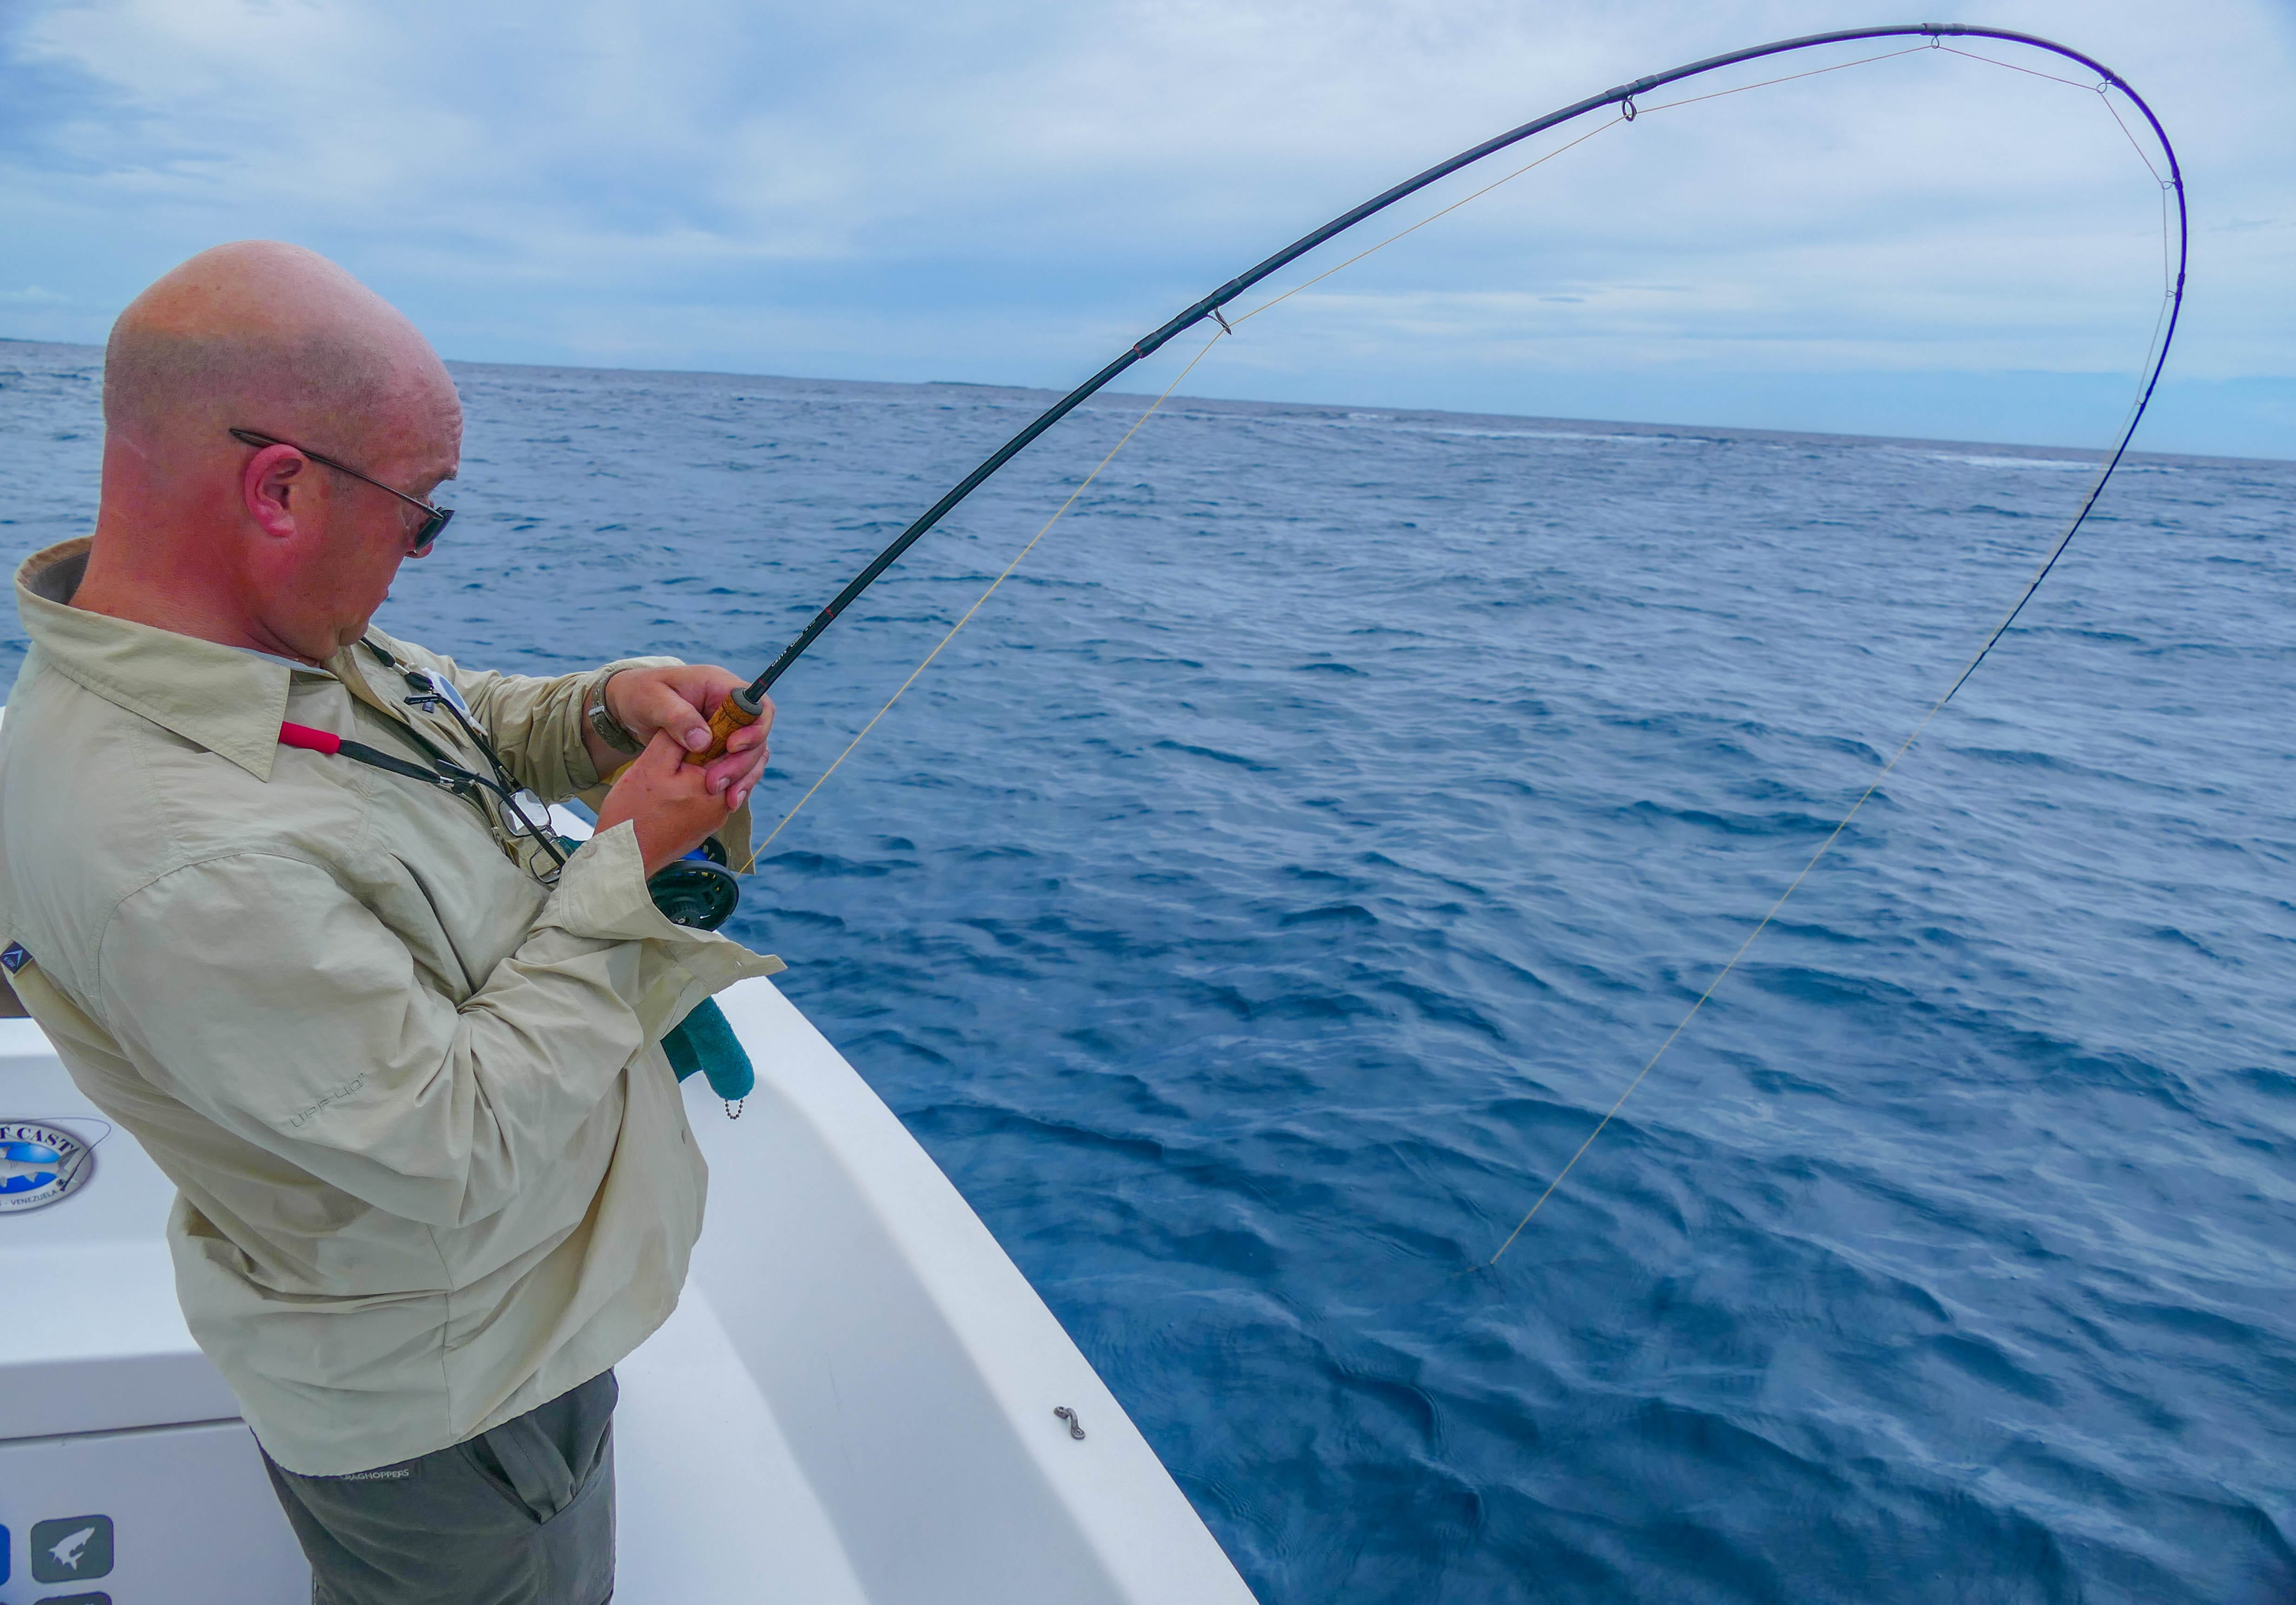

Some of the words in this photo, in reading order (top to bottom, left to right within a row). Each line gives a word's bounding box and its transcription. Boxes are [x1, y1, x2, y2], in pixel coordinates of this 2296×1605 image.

[289, 1098, 330, 1127] UPF
[17, 1127, 74, 1152] CAST
[11, 1190, 56, 1205] VENEZUELA
